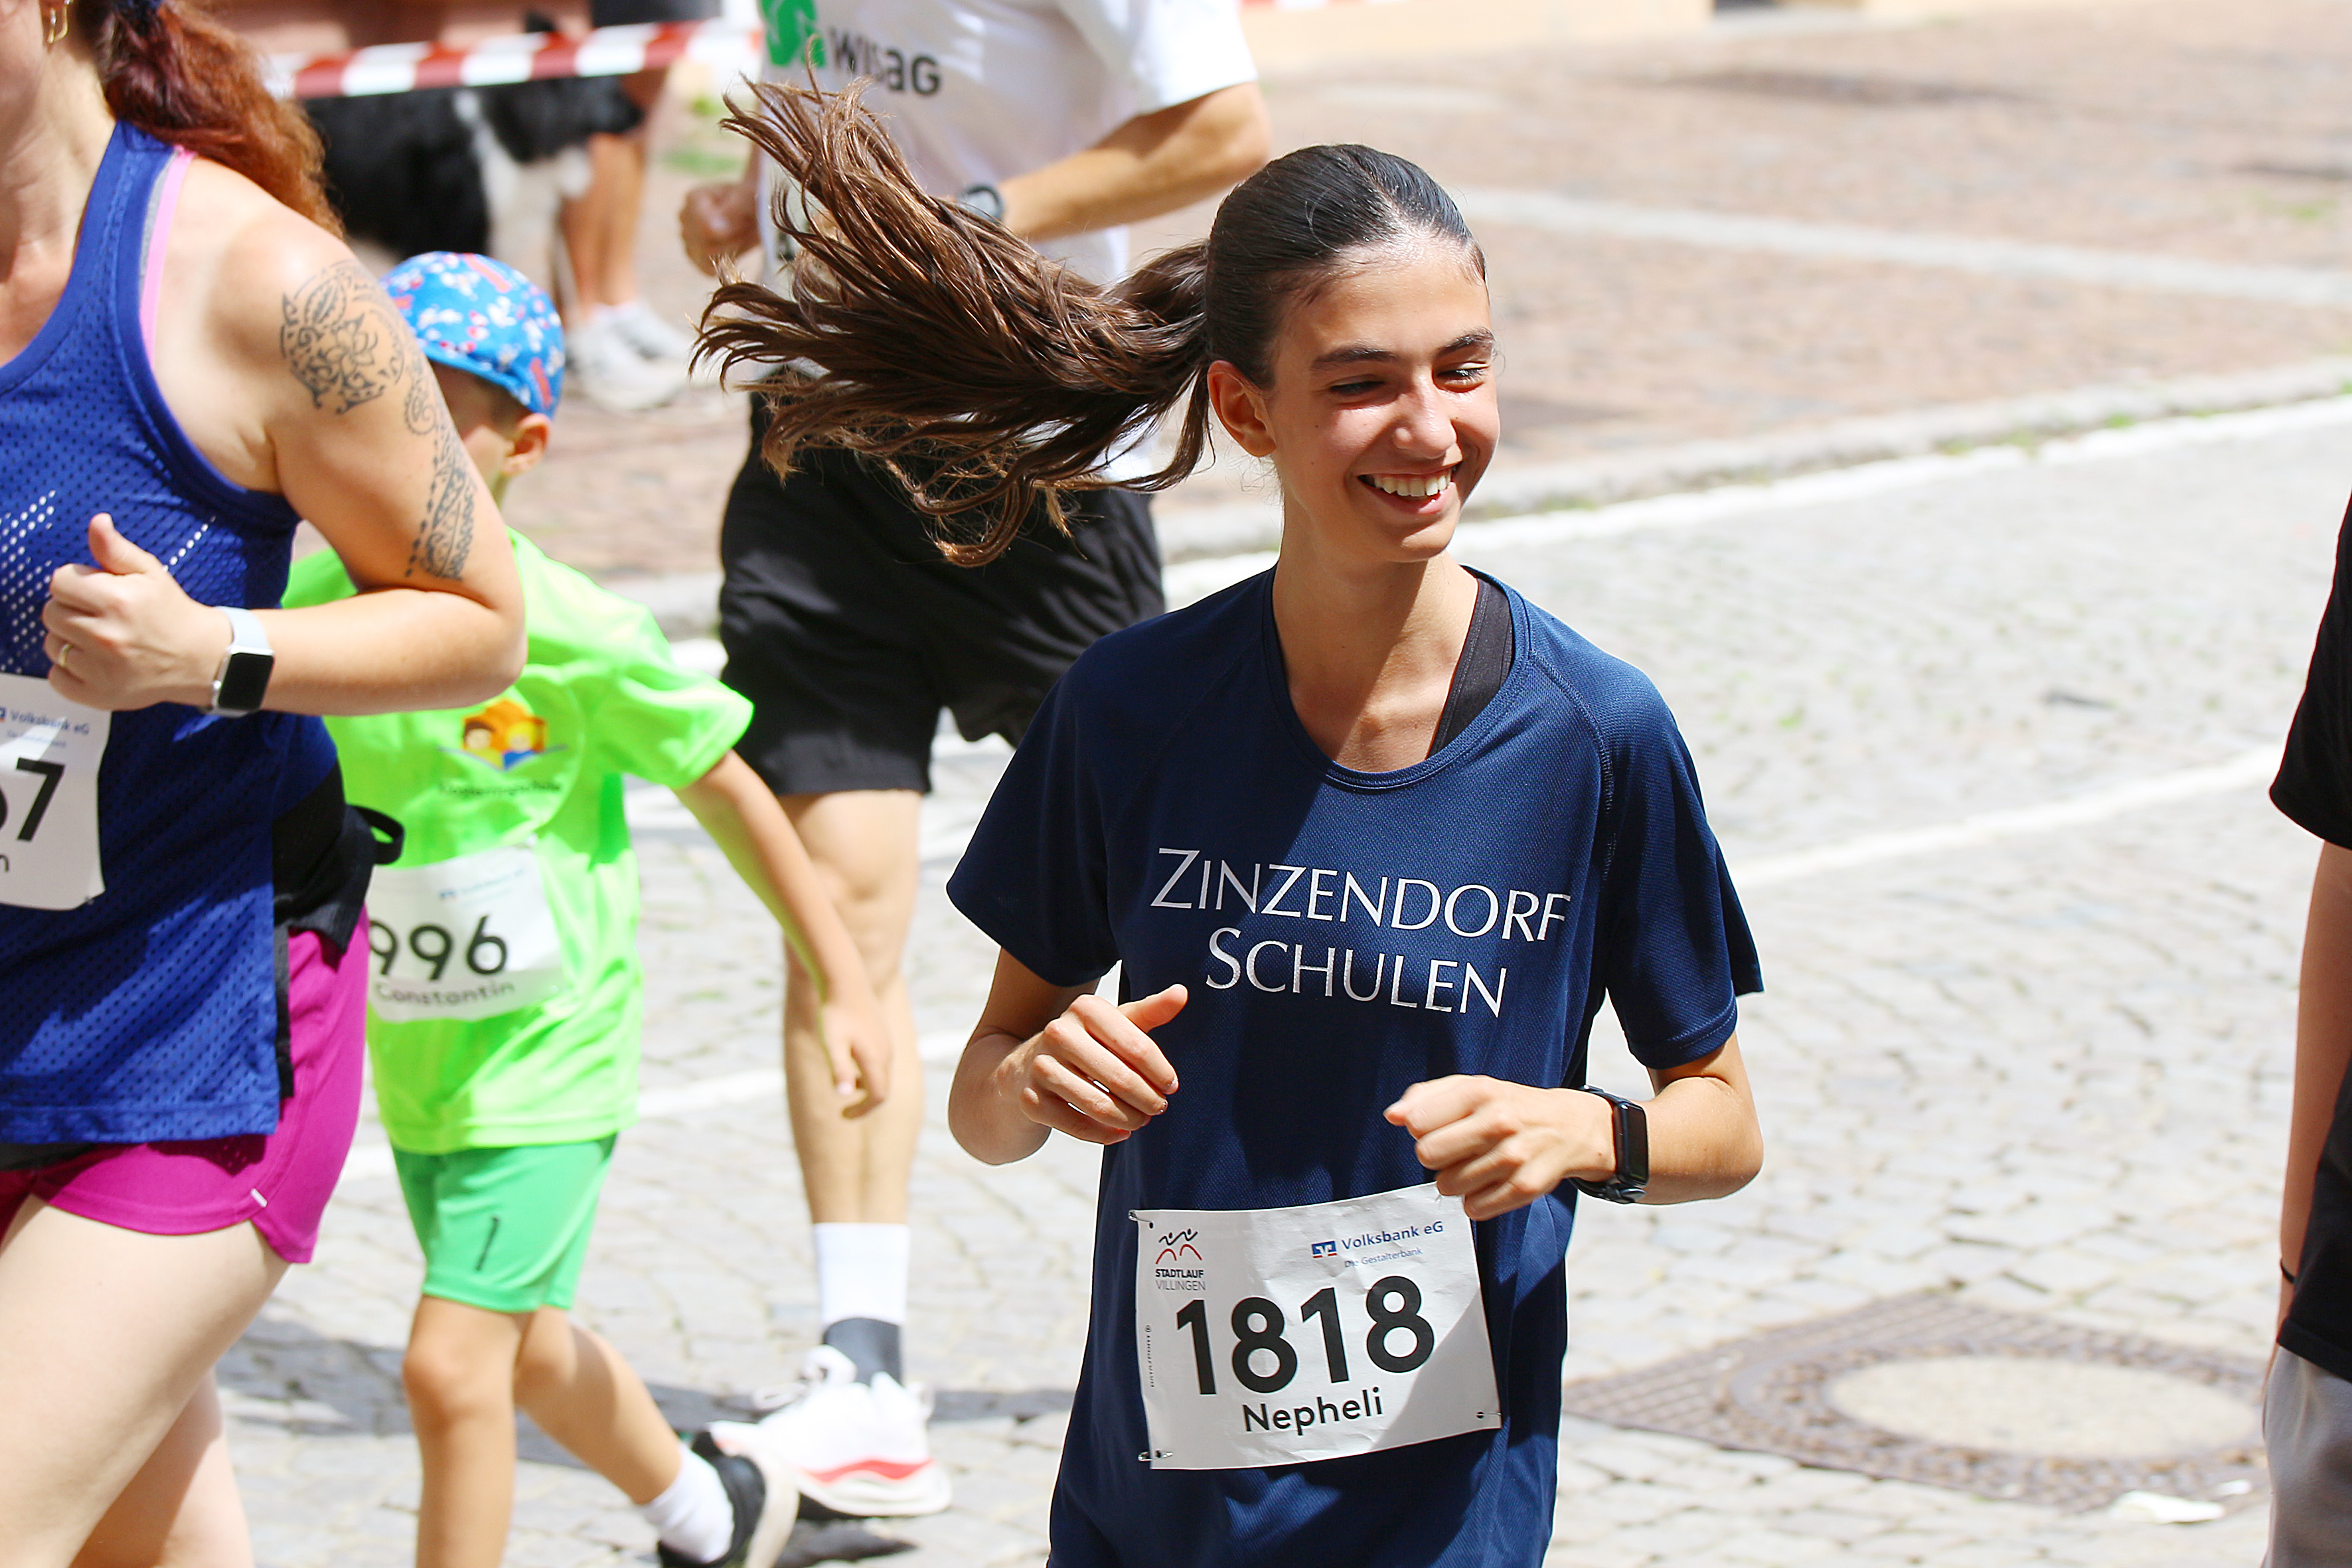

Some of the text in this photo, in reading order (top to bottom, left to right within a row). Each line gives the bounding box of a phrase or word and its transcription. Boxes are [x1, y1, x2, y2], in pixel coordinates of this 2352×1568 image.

[0, 757, 66, 842] 7
[1150, 847, 1571, 942] ZINZENDORF
[369, 914, 508, 981] 996
[1206, 927, 1507, 1018] SCHULEN
[374, 980, 515, 1006] Constantin
[1341, 1221, 1444, 1250] Volksbank eG
[1361, 1247, 1423, 1265] Gestalterbank
[1155, 1268, 1205, 1279] STADTLAUF
[1155, 1280, 1206, 1291] VILLINGEN
[1176, 1275, 1435, 1395] 1818
[1241, 1386, 1383, 1437] Nepheli
